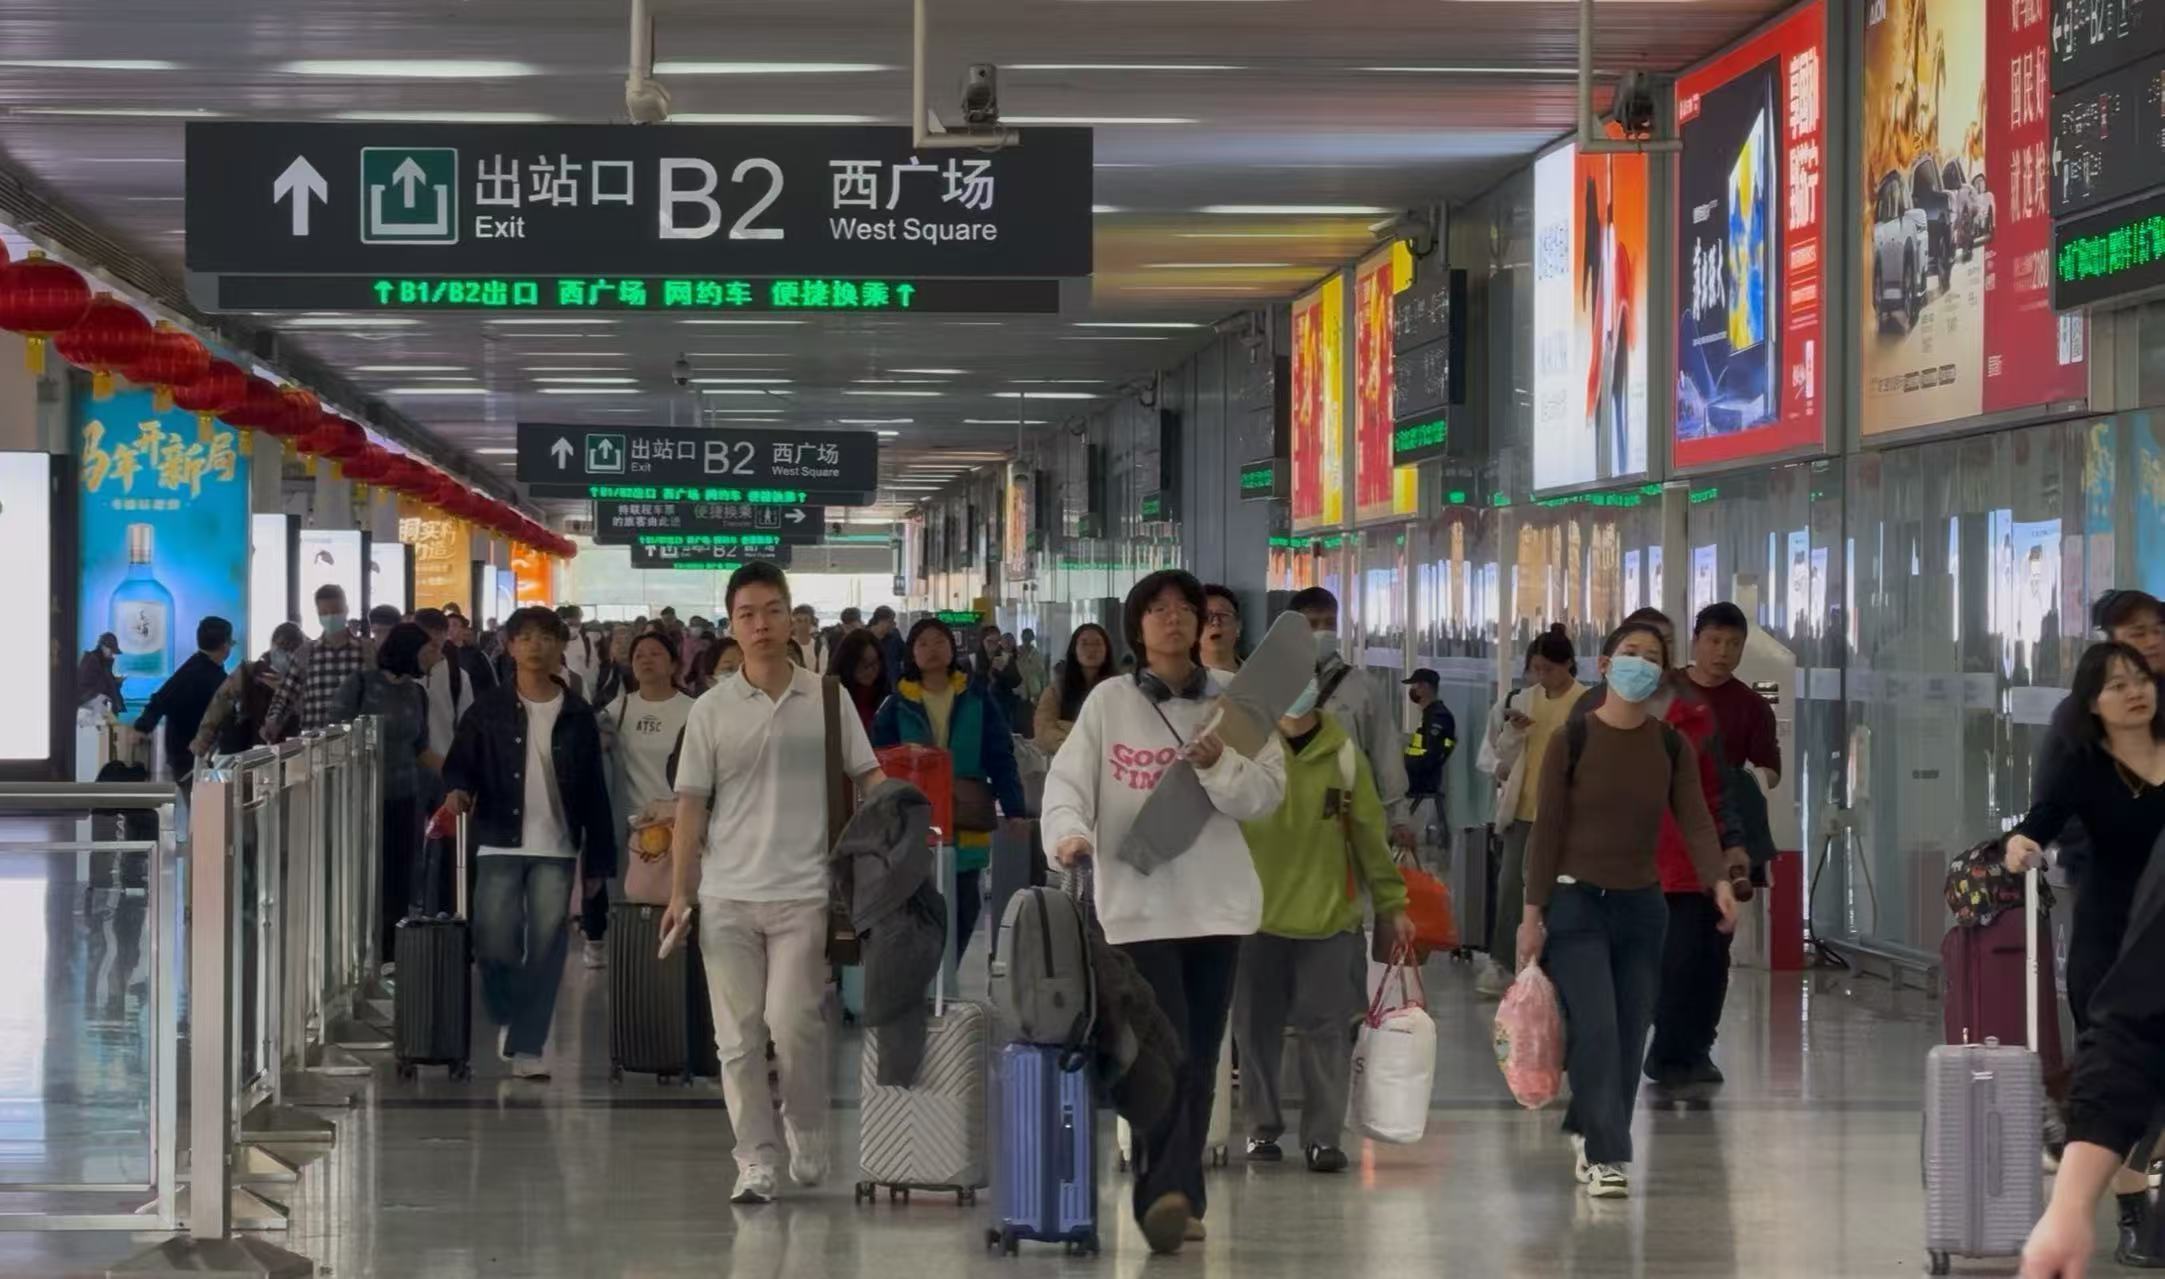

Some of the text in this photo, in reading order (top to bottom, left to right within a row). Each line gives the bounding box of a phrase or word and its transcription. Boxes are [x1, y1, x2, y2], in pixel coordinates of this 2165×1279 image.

[475, 153, 996, 240] 出站口 B2 西广场
[475, 215, 526, 239] Exit
[828, 217, 998, 246] West Square
[400, 280, 890, 306] B1/B2出口 西广场 网约车 便捷换乘
[631, 438, 840, 475] 出站口 B2 西广场
[631, 462, 652, 473] Exit
[771, 465, 841, 479] West Square
[1111, 743, 1177, 767] GOO
[1108, 758, 1164, 790] TIM
